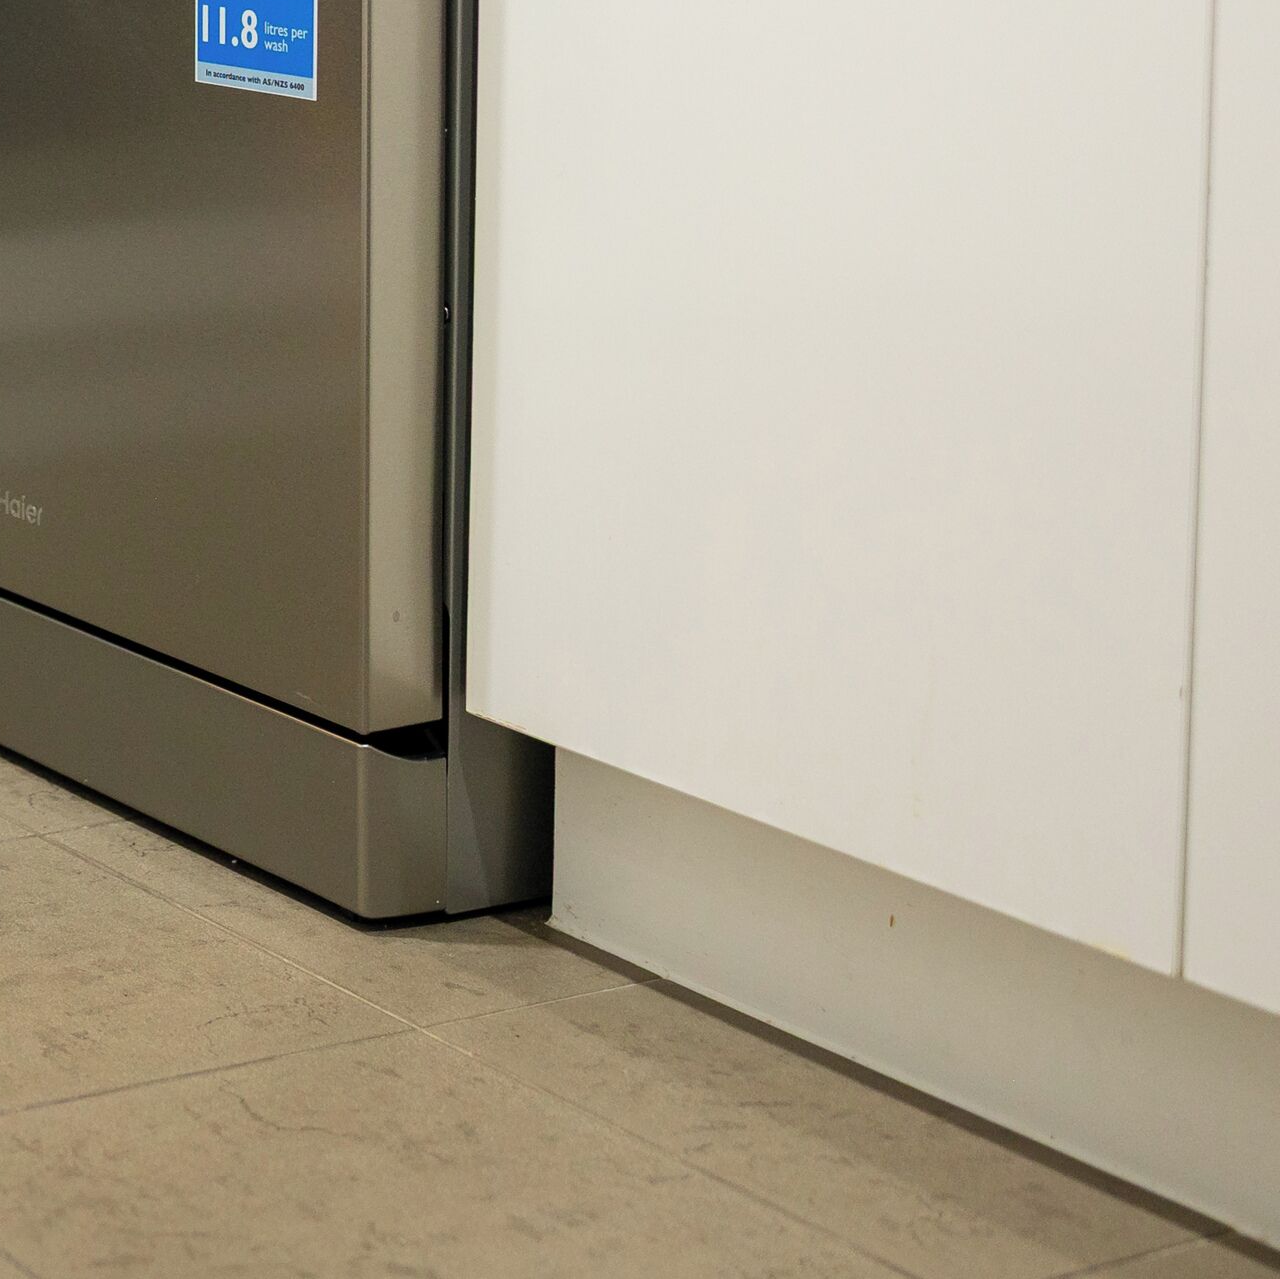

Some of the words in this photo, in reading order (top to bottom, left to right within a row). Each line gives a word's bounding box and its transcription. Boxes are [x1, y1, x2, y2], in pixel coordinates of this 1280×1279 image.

[202, 4, 258, 50] 11.8
[264, 21, 288, 37] litres
[291, 27, 308, 42] per
[264, 40, 288, 53] wash
[205, 68, 212, 77] In
[213, 70, 246, 82] accordance
[247, 76, 261, 85] with
[262, 78, 288, 89] AS/NZS
[289, 82, 305, 91] 6400
